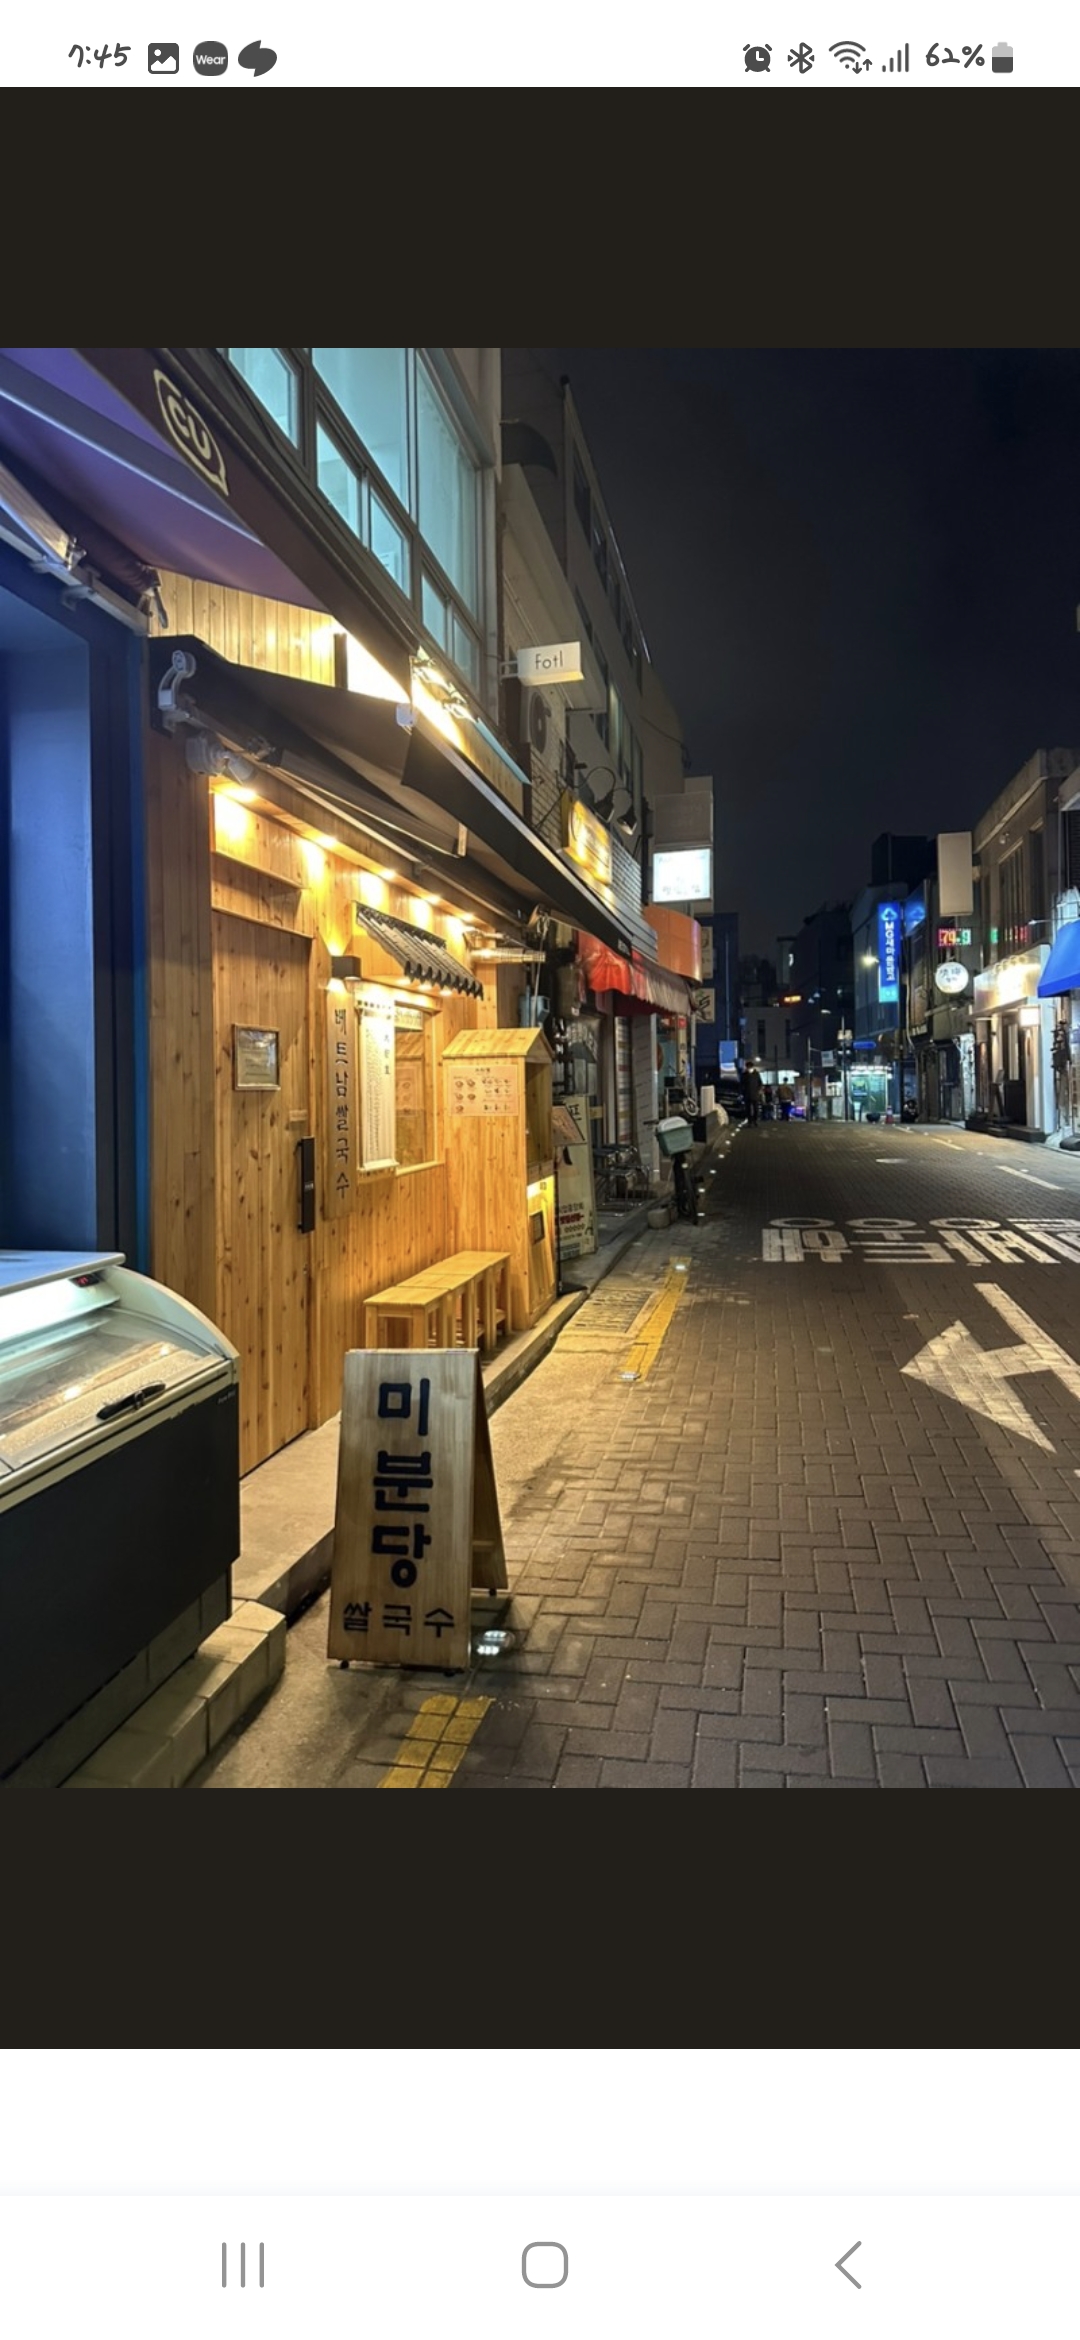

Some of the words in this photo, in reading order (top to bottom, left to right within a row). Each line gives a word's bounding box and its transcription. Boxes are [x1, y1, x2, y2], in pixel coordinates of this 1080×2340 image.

[167, 395, 211, 460] CU
[371, 1378, 434, 1588] 미분당
[343, 1602, 455, 1638] 쌀국수
